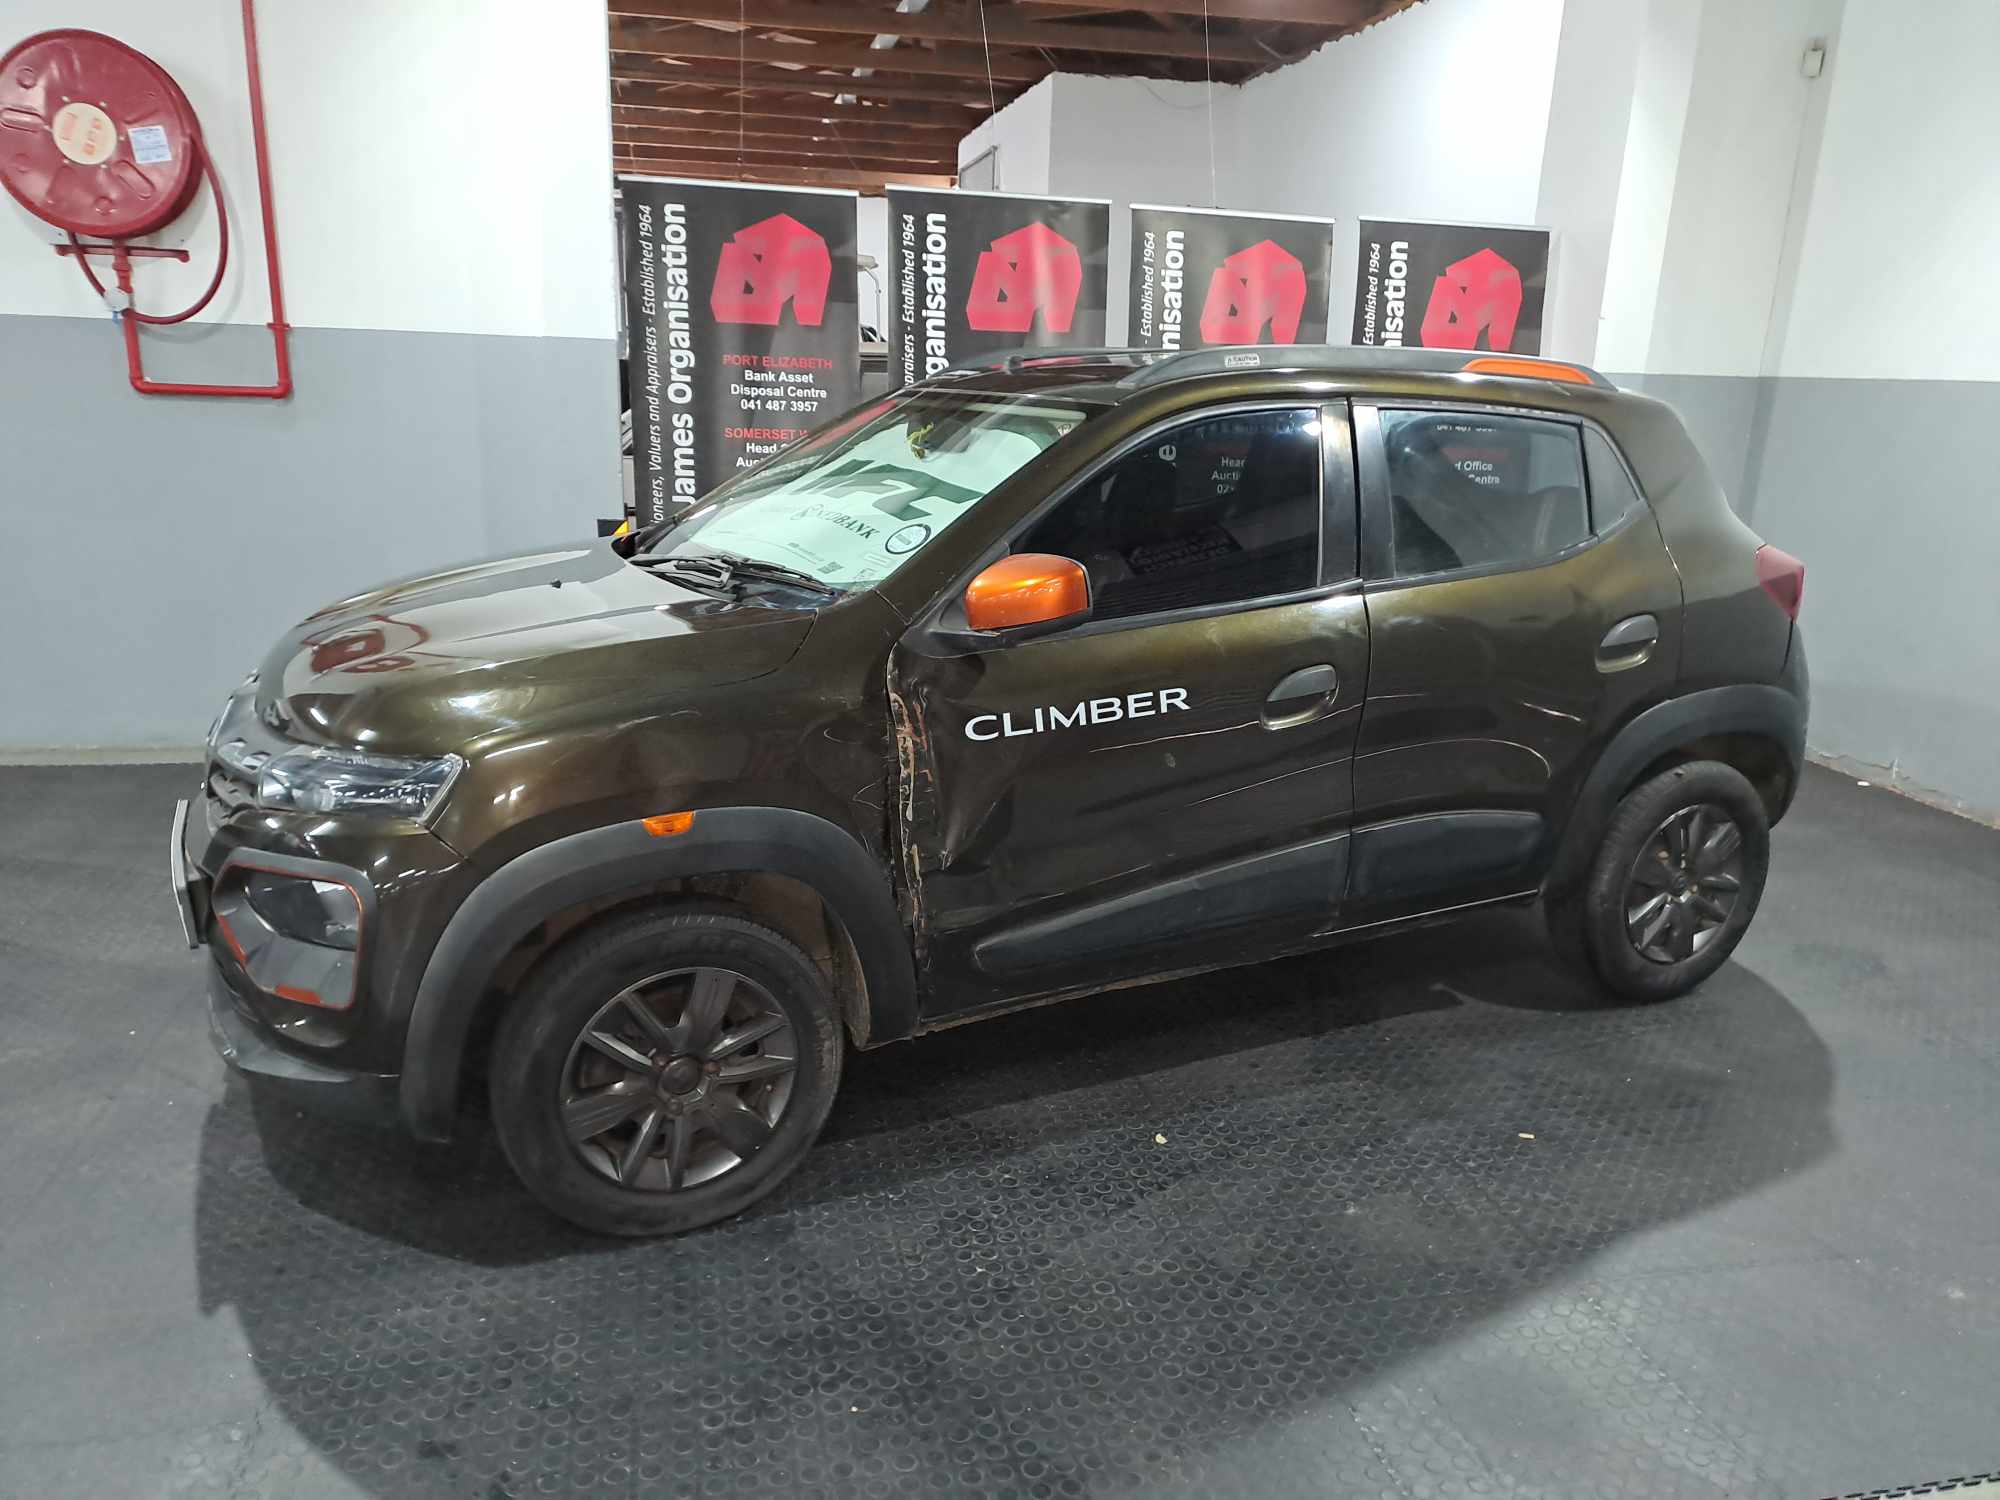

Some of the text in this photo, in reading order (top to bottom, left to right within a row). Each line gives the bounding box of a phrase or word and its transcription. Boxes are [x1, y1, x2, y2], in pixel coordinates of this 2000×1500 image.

[639, 204, 653, 237] 1964
[902, 213, 915, 246] 1964
[1143, 231, 1155, 263] 1964
[638, 240, 656, 315] Established
[902, 249, 915, 324] Established
[1159, 230, 1184, 350] nisation
[1362, 242, 1381, 345] Established 1964
[1140, 265, 1154, 337] Established
[643, 326, 661, 394] Appraisers
[661, 203, 696, 505] James Organisation
[722, 354, 833, 369] PORT ELIZABETH
[730, 384, 827, 399] Disposal Centre
[744, 369, 814, 383] Bank Asset
[646, 396, 661, 421] and
[740, 399, 818, 412] 041 487 3957
[648, 424, 662, 471] Valuers
[723, 427, 796, 440] SOMERSET
[745, 442, 777, 454] Head
[1211, 469, 1241, 481] Aucti
[1463, 460, 1494, 472] Office
[964, 687, 1191, 742] CLIMBER
